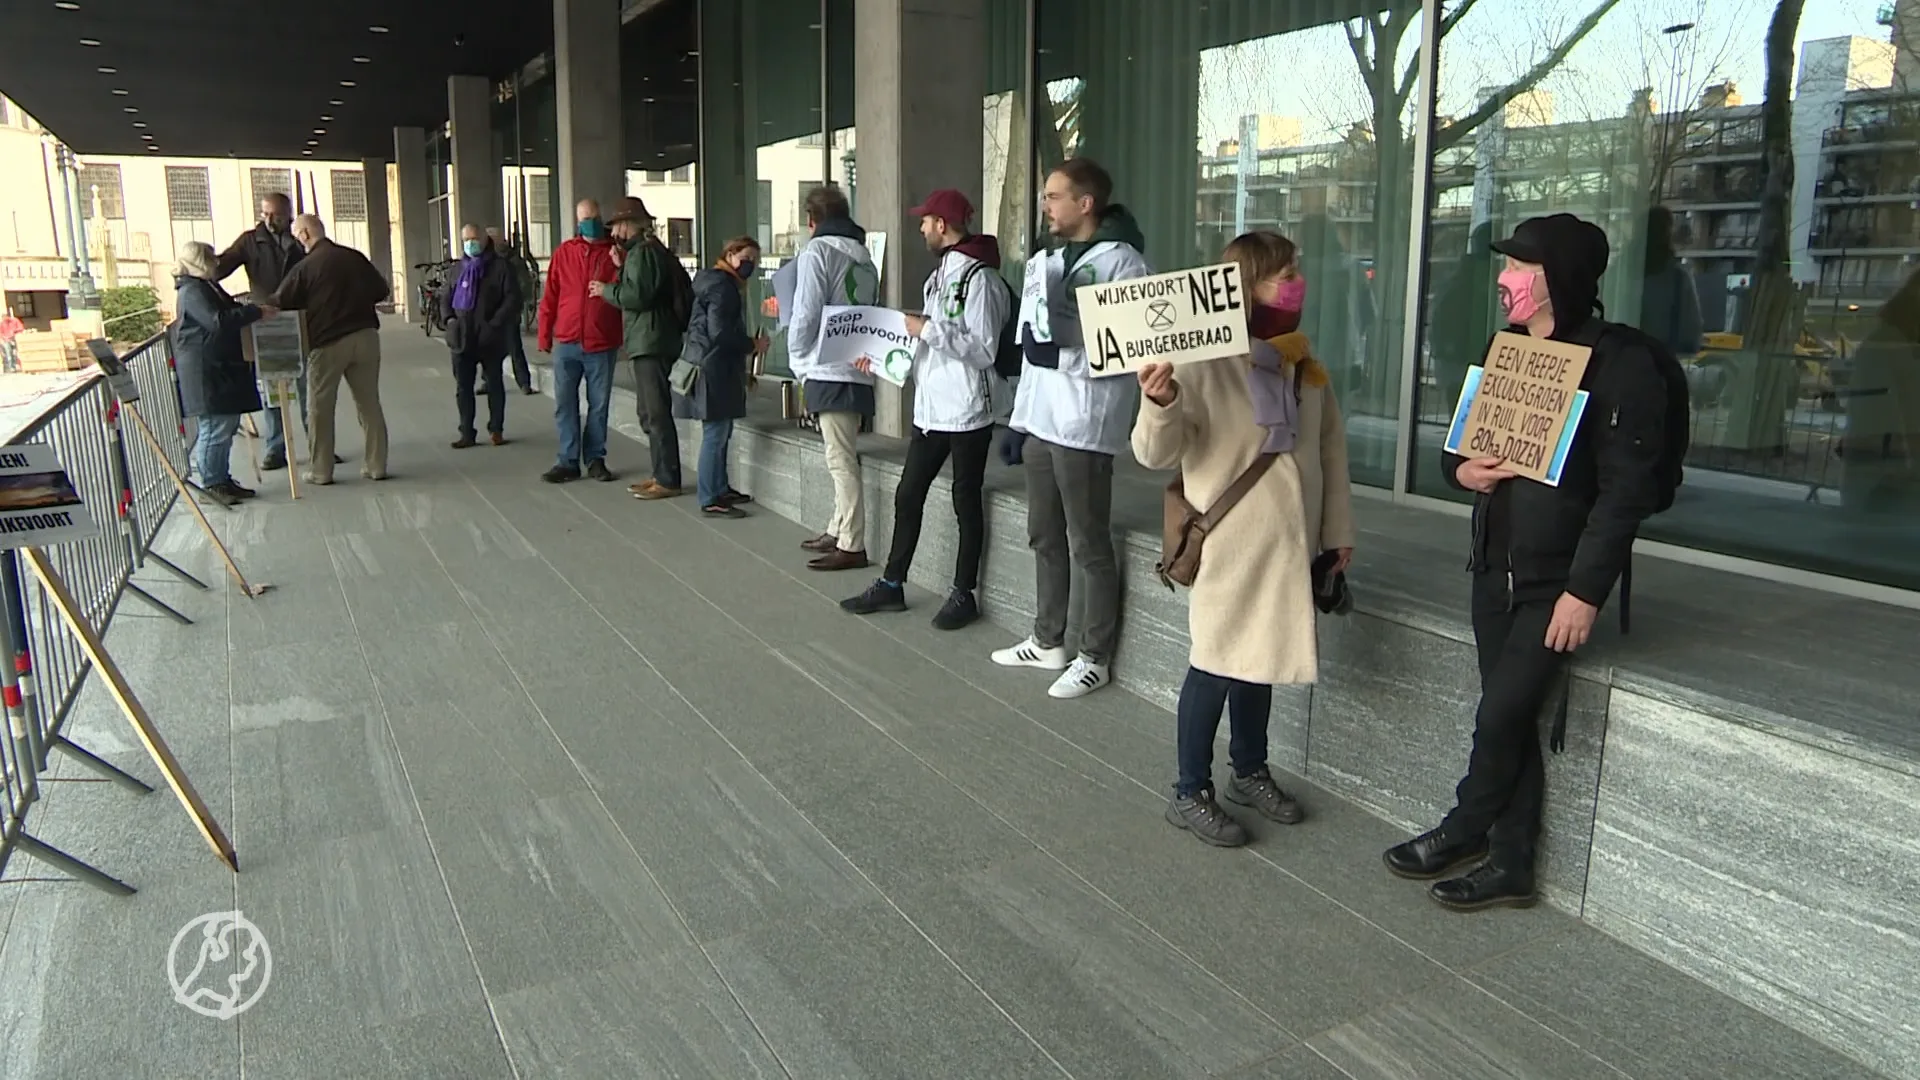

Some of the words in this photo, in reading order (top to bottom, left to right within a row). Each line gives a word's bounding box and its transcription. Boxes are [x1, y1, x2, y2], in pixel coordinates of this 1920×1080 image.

[1094, 276, 1186, 306] WIJKEVOORT
[1188, 266, 1241, 316] NEE
[826, 323, 914, 349] Wijkevoort!
[828, 313, 863, 327] Stop
[1090, 326, 1126, 371] JA
[1126, 325, 1232, 358] BURGERBERAAD
[1495, 346, 1526, 374] EEN
[1524, 352, 1571, 383] REEPJE
[1482, 373, 1568, 414] EXCUUSGROEN
[1476, 401, 1492, 424] IN
[1491, 405, 1517, 432] RUIL
[1519, 411, 1554, 442] VOOR
[1470, 427, 1500, 459] 80ha
[1502, 435, 1547, 471] DOZEN
